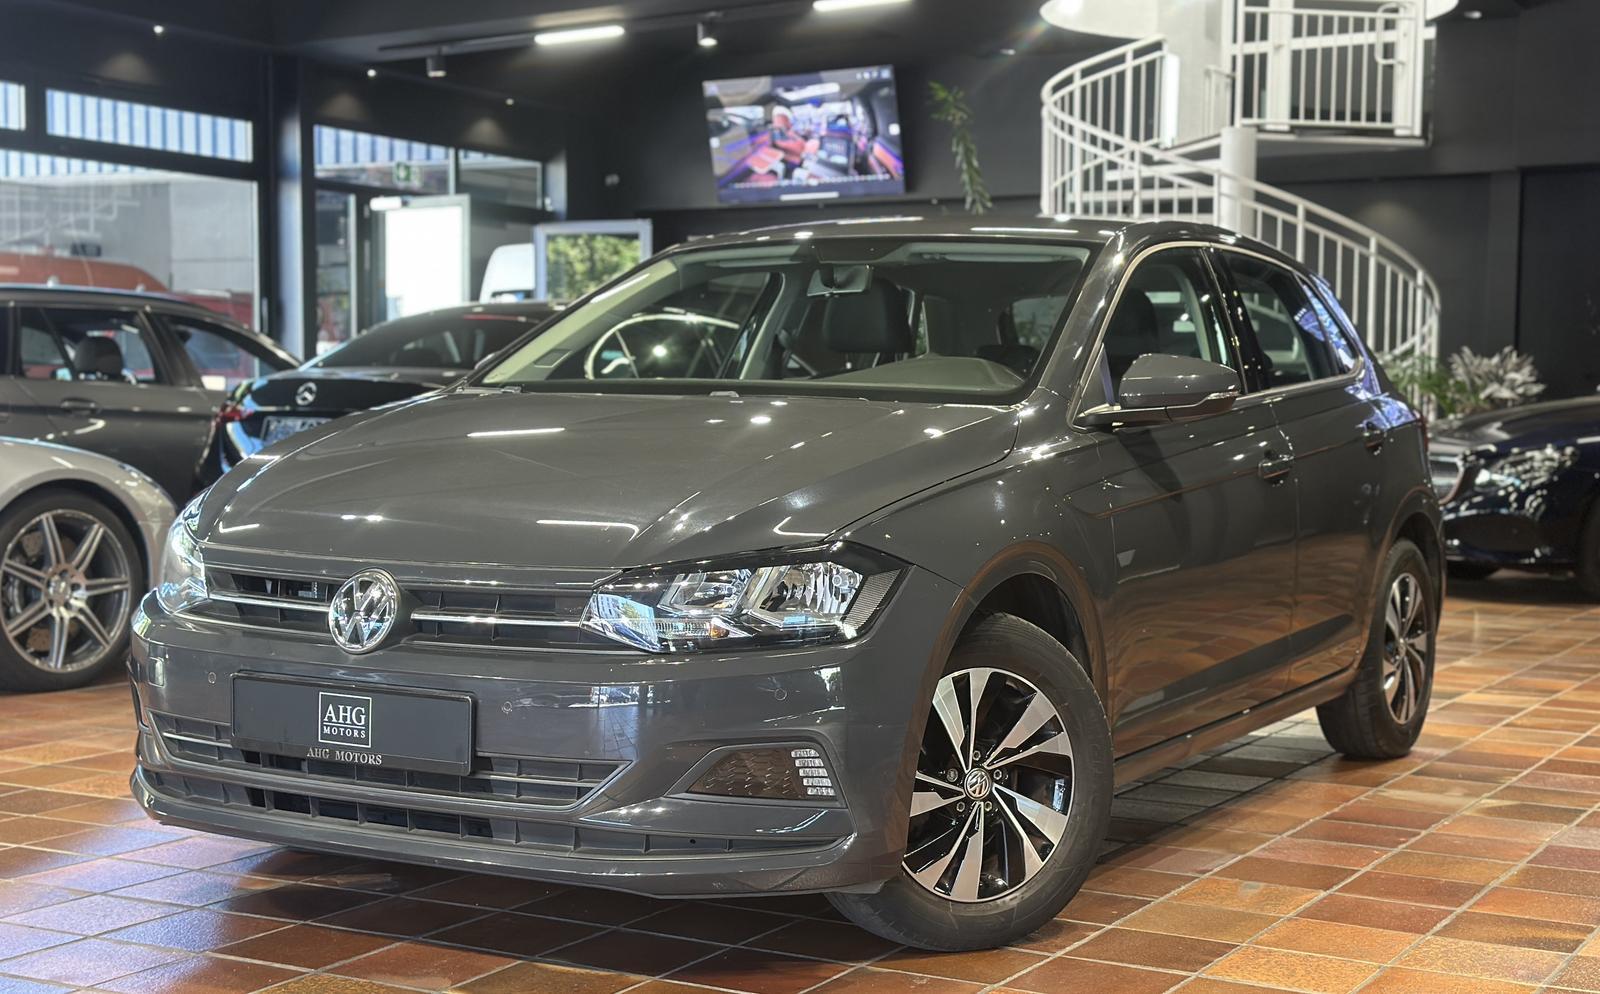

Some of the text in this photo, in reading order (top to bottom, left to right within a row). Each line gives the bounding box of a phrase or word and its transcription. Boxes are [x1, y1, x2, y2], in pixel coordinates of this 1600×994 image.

[323, 704, 366, 725] AHG
[323, 726, 366, 739] MOTORS
[307, 747, 382, 766] AHG MOTORS
